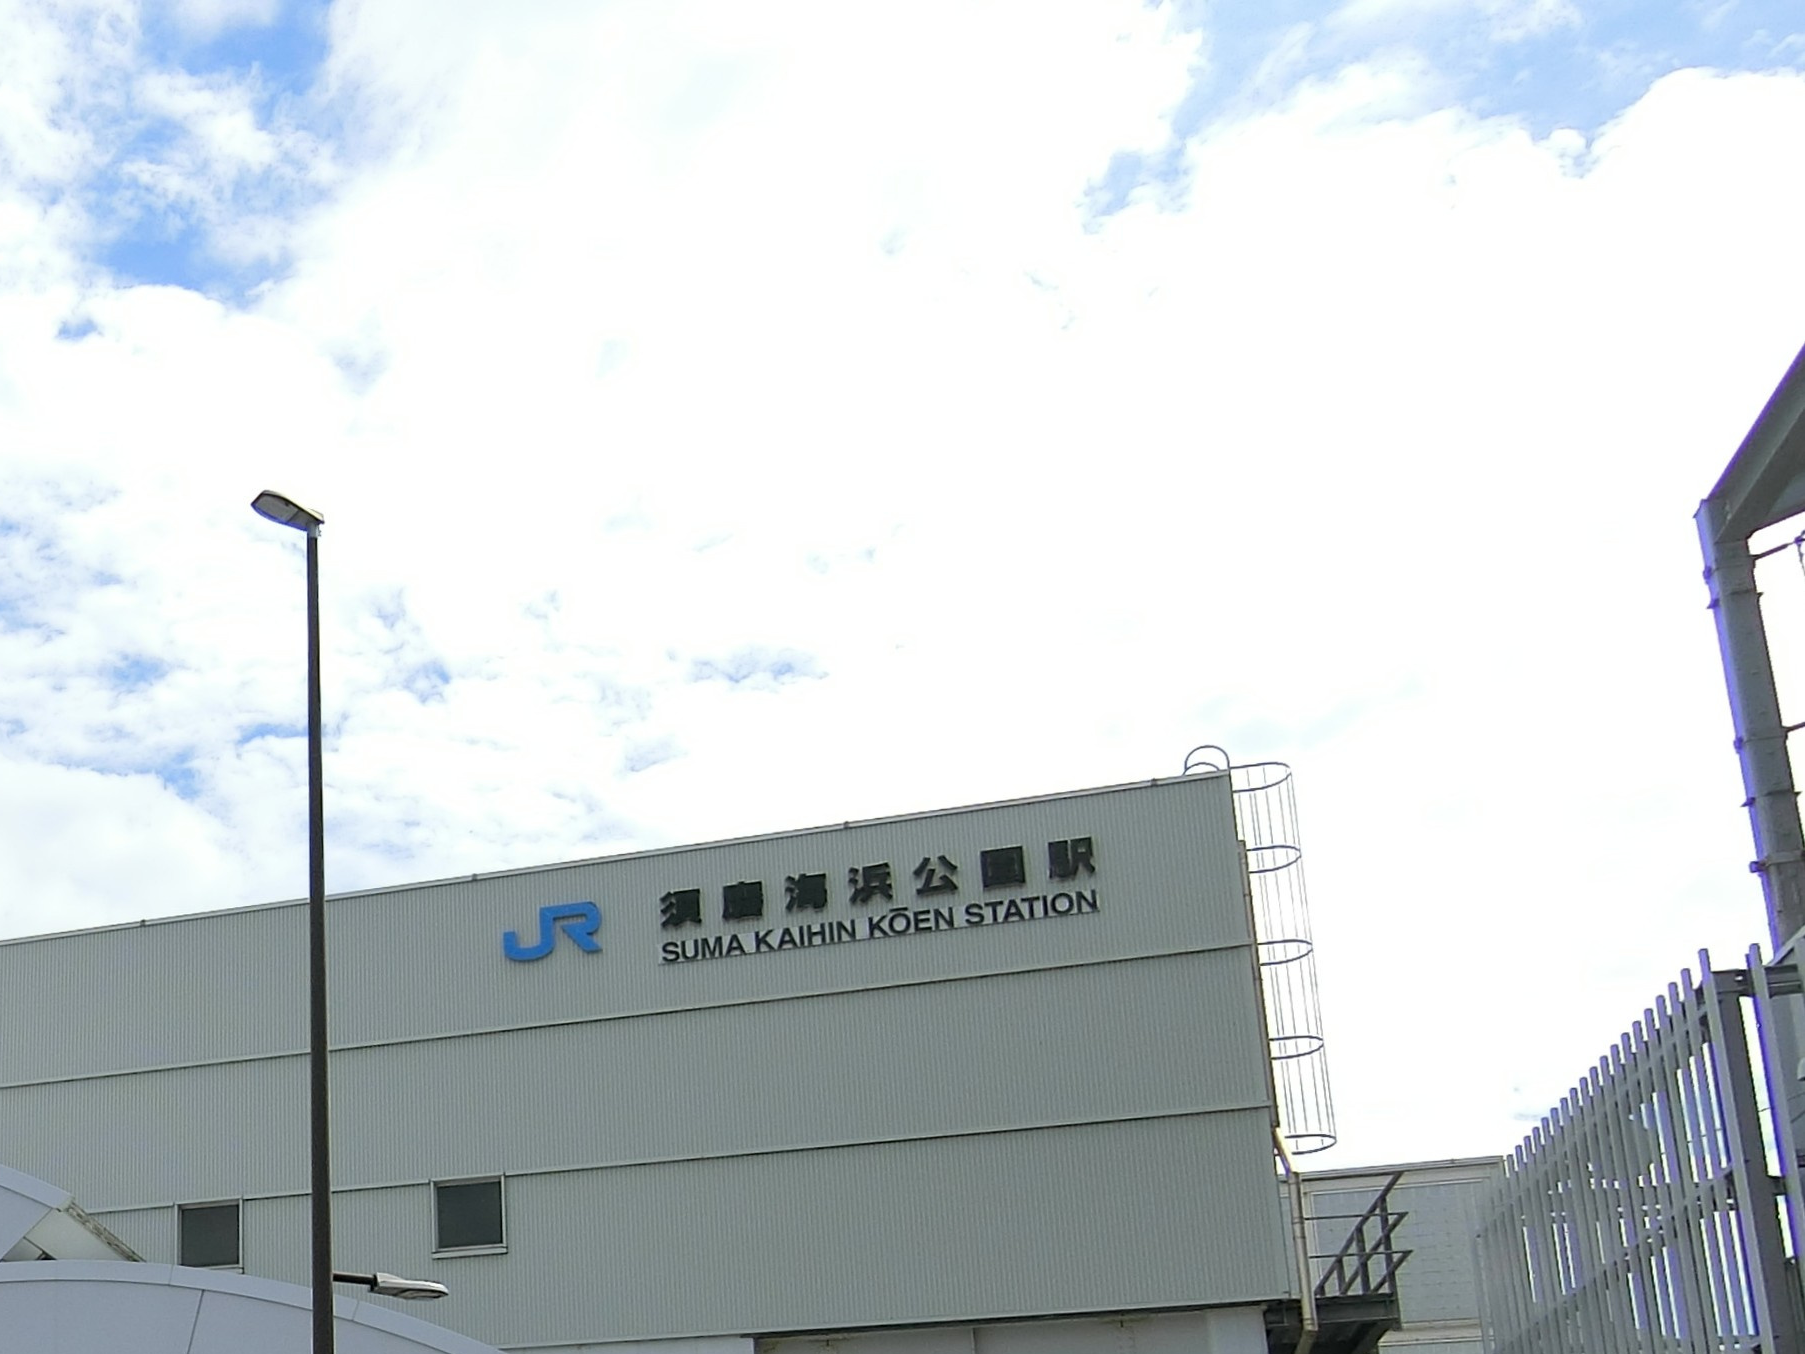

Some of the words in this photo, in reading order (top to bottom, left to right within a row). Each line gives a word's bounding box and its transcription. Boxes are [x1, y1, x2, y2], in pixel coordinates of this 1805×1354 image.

[659, 836, 1096, 928] 須磨海浜公園駅
[502, 900, 603, 962] JR
[661, 933, 746, 962] SUMA
[754, 918, 856, 951] KAIHIN
[867, 906, 955, 938] KŌEN
[964, 889, 1099, 925] STATION
